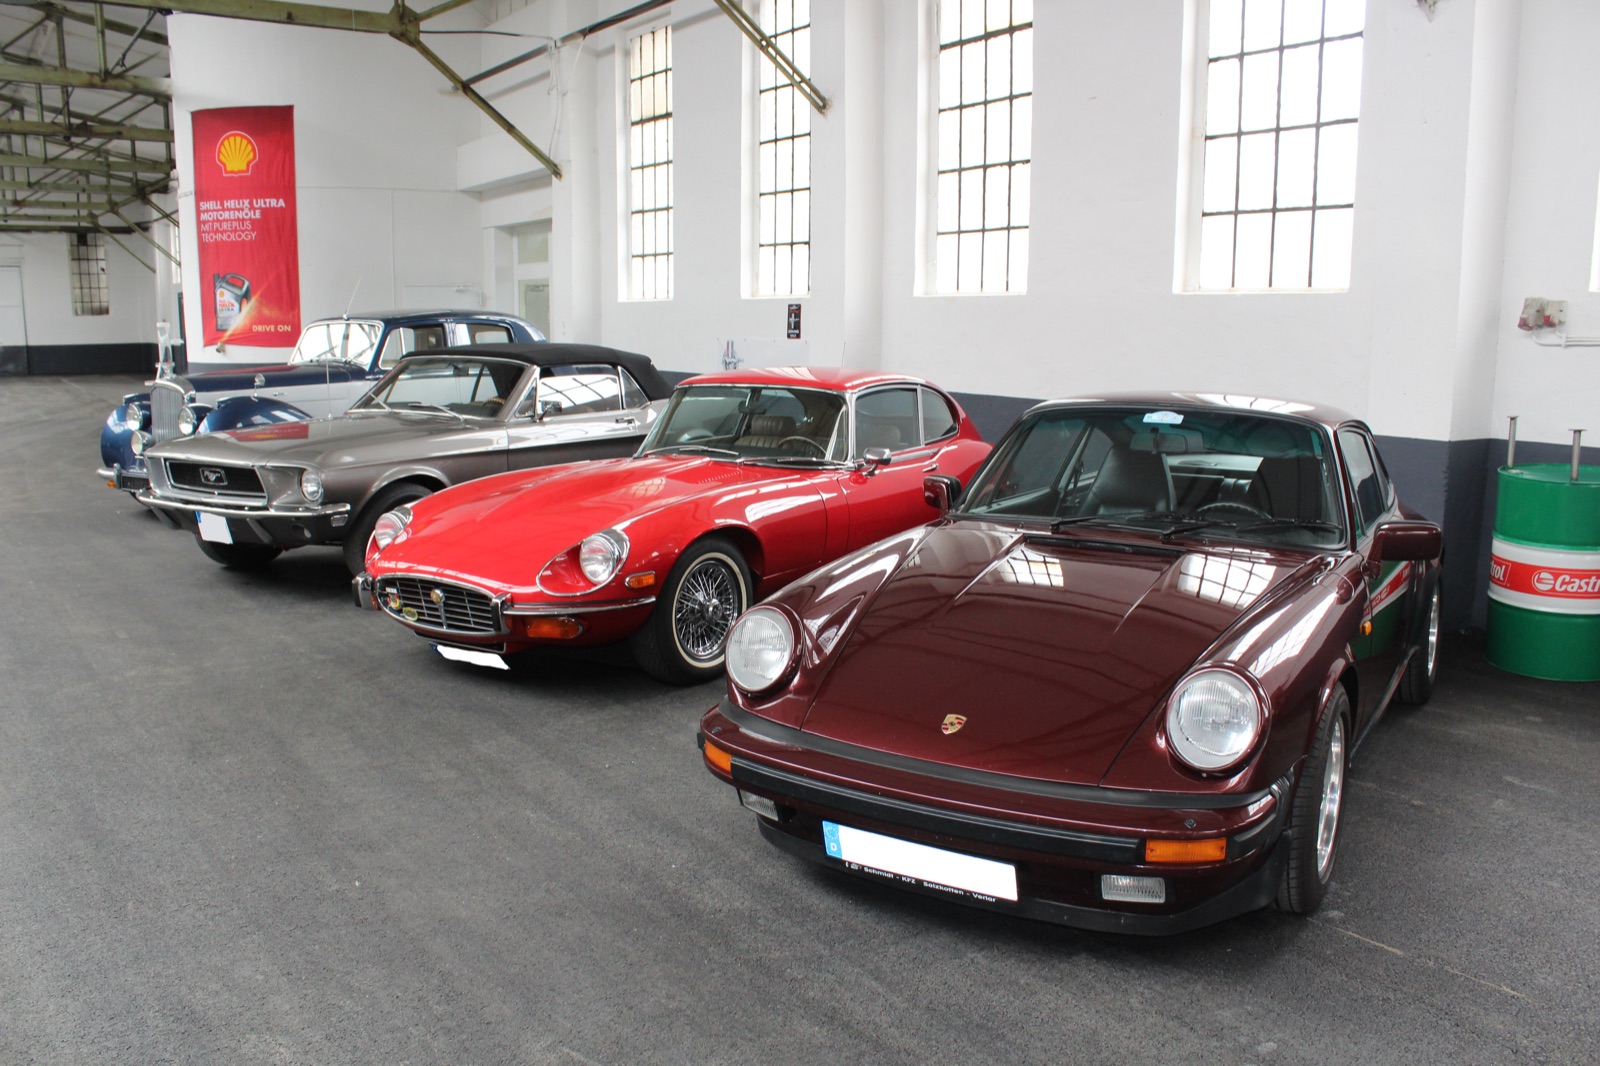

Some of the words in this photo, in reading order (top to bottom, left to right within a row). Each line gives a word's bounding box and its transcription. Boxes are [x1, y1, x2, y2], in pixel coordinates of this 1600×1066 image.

[200, 201, 222, 210] SHELL
[224, 199, 250, 209] HELIX
[253, 198, 286, 208] ULTRA
[200, 207, 261, 221] MOTORENÖLE
[201, 222, 212, 231] MIT
[201, 231, 257, 243] TECHNOLOGY
[830, 842, 838, 851] D
[863, 866, 894, 879] Schmidt
[922, 881, 965, 896] Salzkotten
